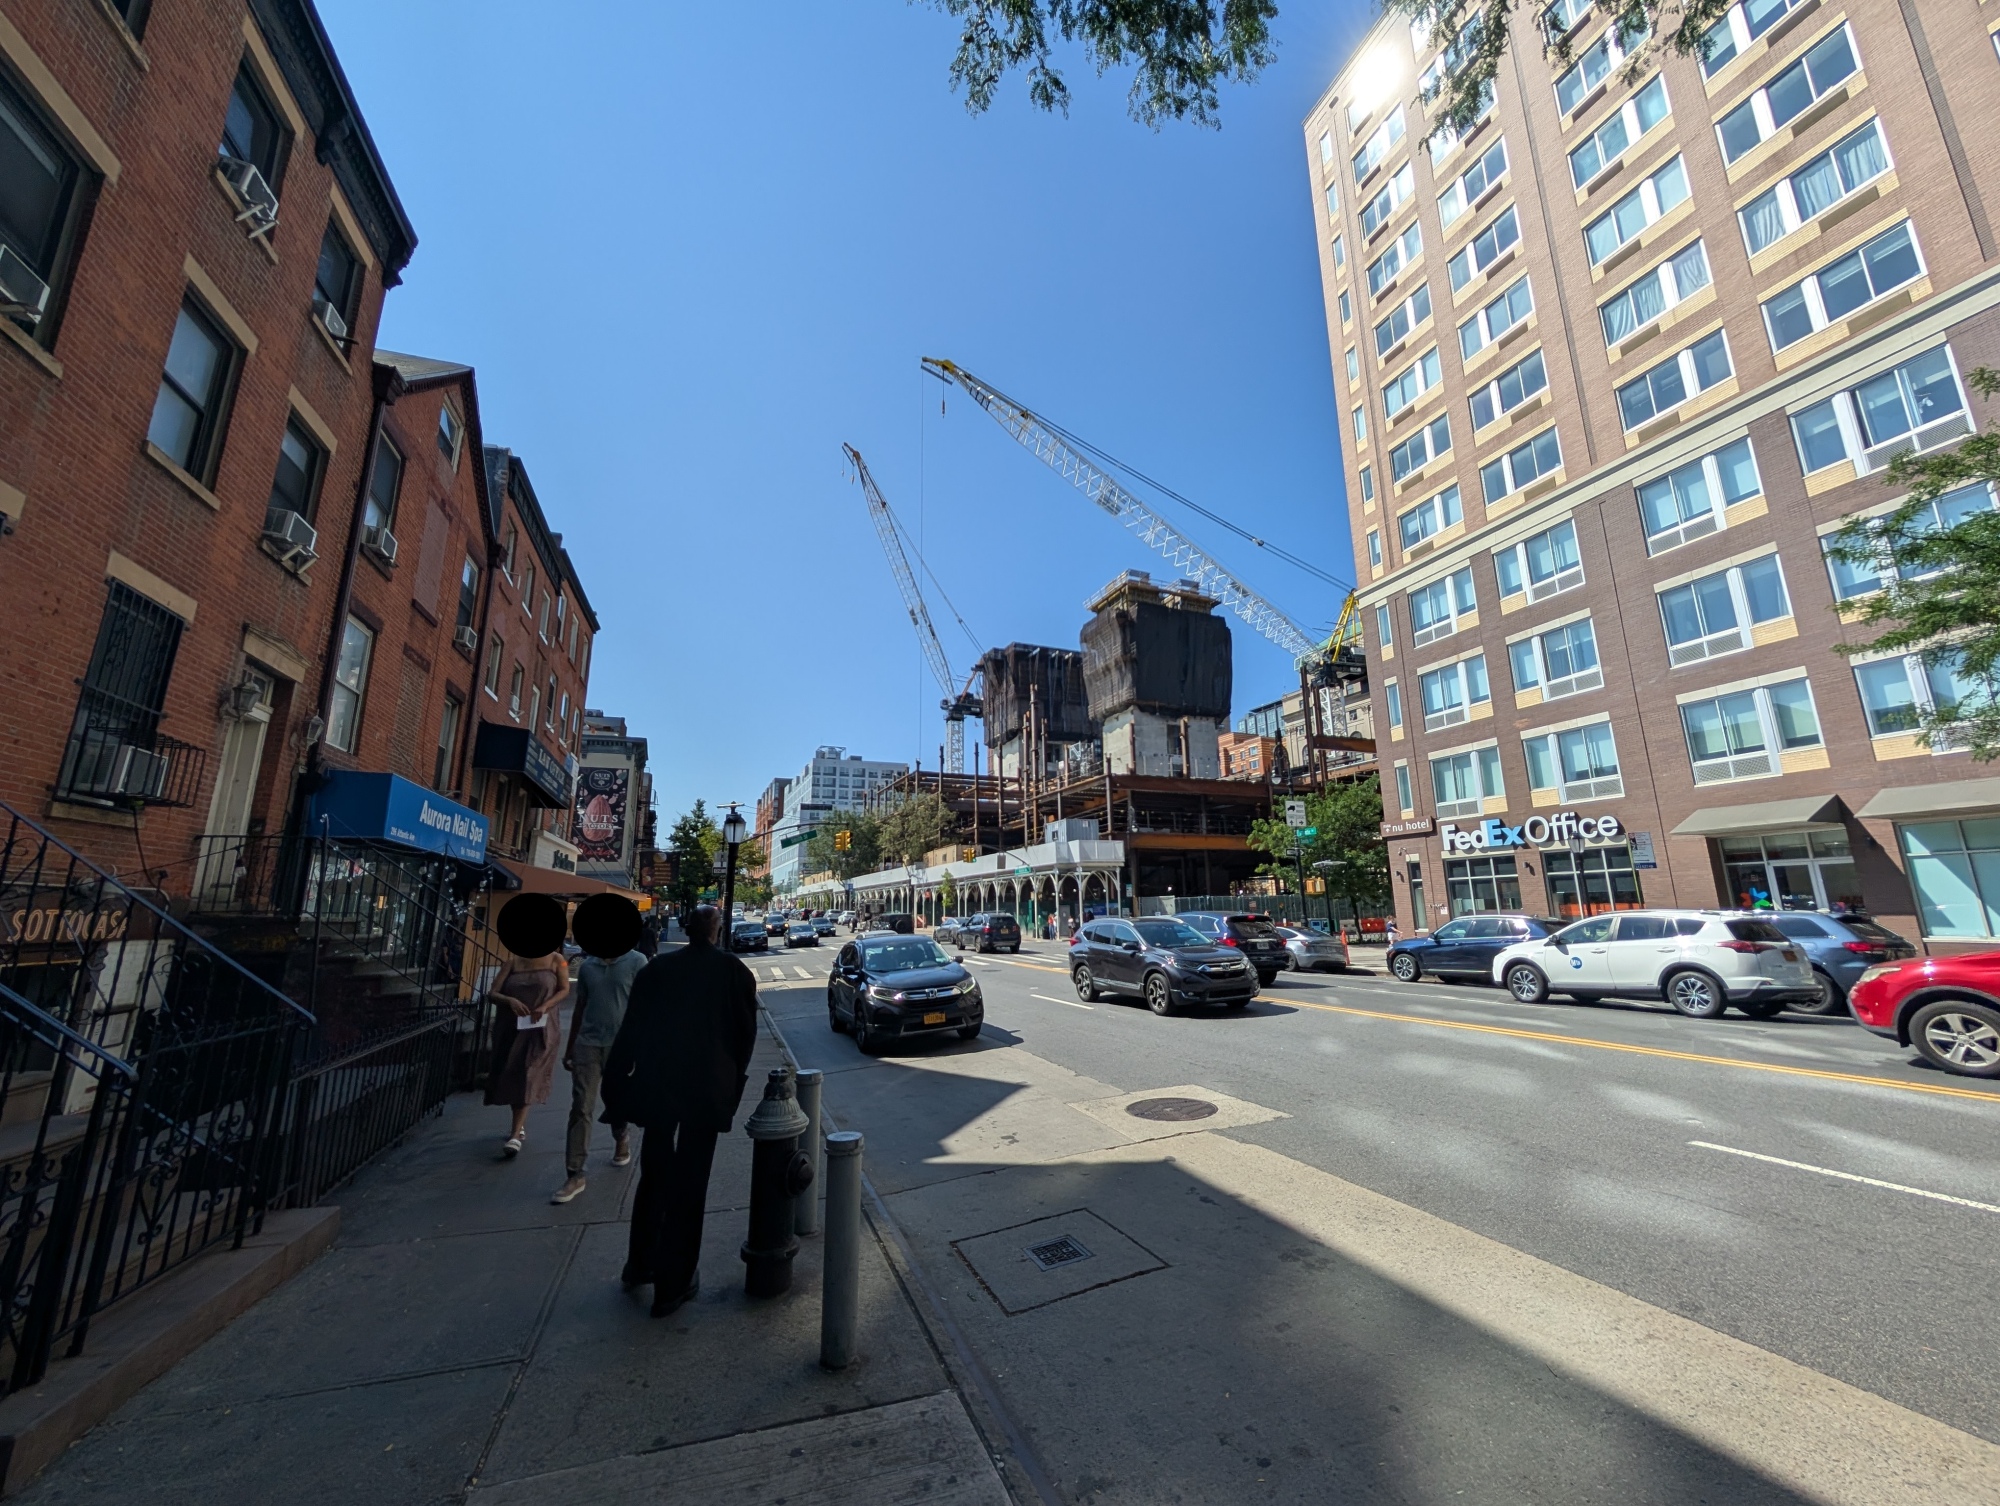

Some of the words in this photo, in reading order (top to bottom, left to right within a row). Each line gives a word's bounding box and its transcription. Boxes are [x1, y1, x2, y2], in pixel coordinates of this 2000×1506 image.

[419, 799, 451, 833] Aurora
[452, 813, 470, 838] Nail
[469, 820, 483, 846] Spa
[578, 814, 618, 823] NUTS
[1392, 824, 1403, 832] nu
[1405, 818, 1429, 831] hotel
[1441, 818, 1525, 851] FedEx
[1524, 811, 1619, 844] Office
[6, 908, 129, 943] SOTTOCASA
